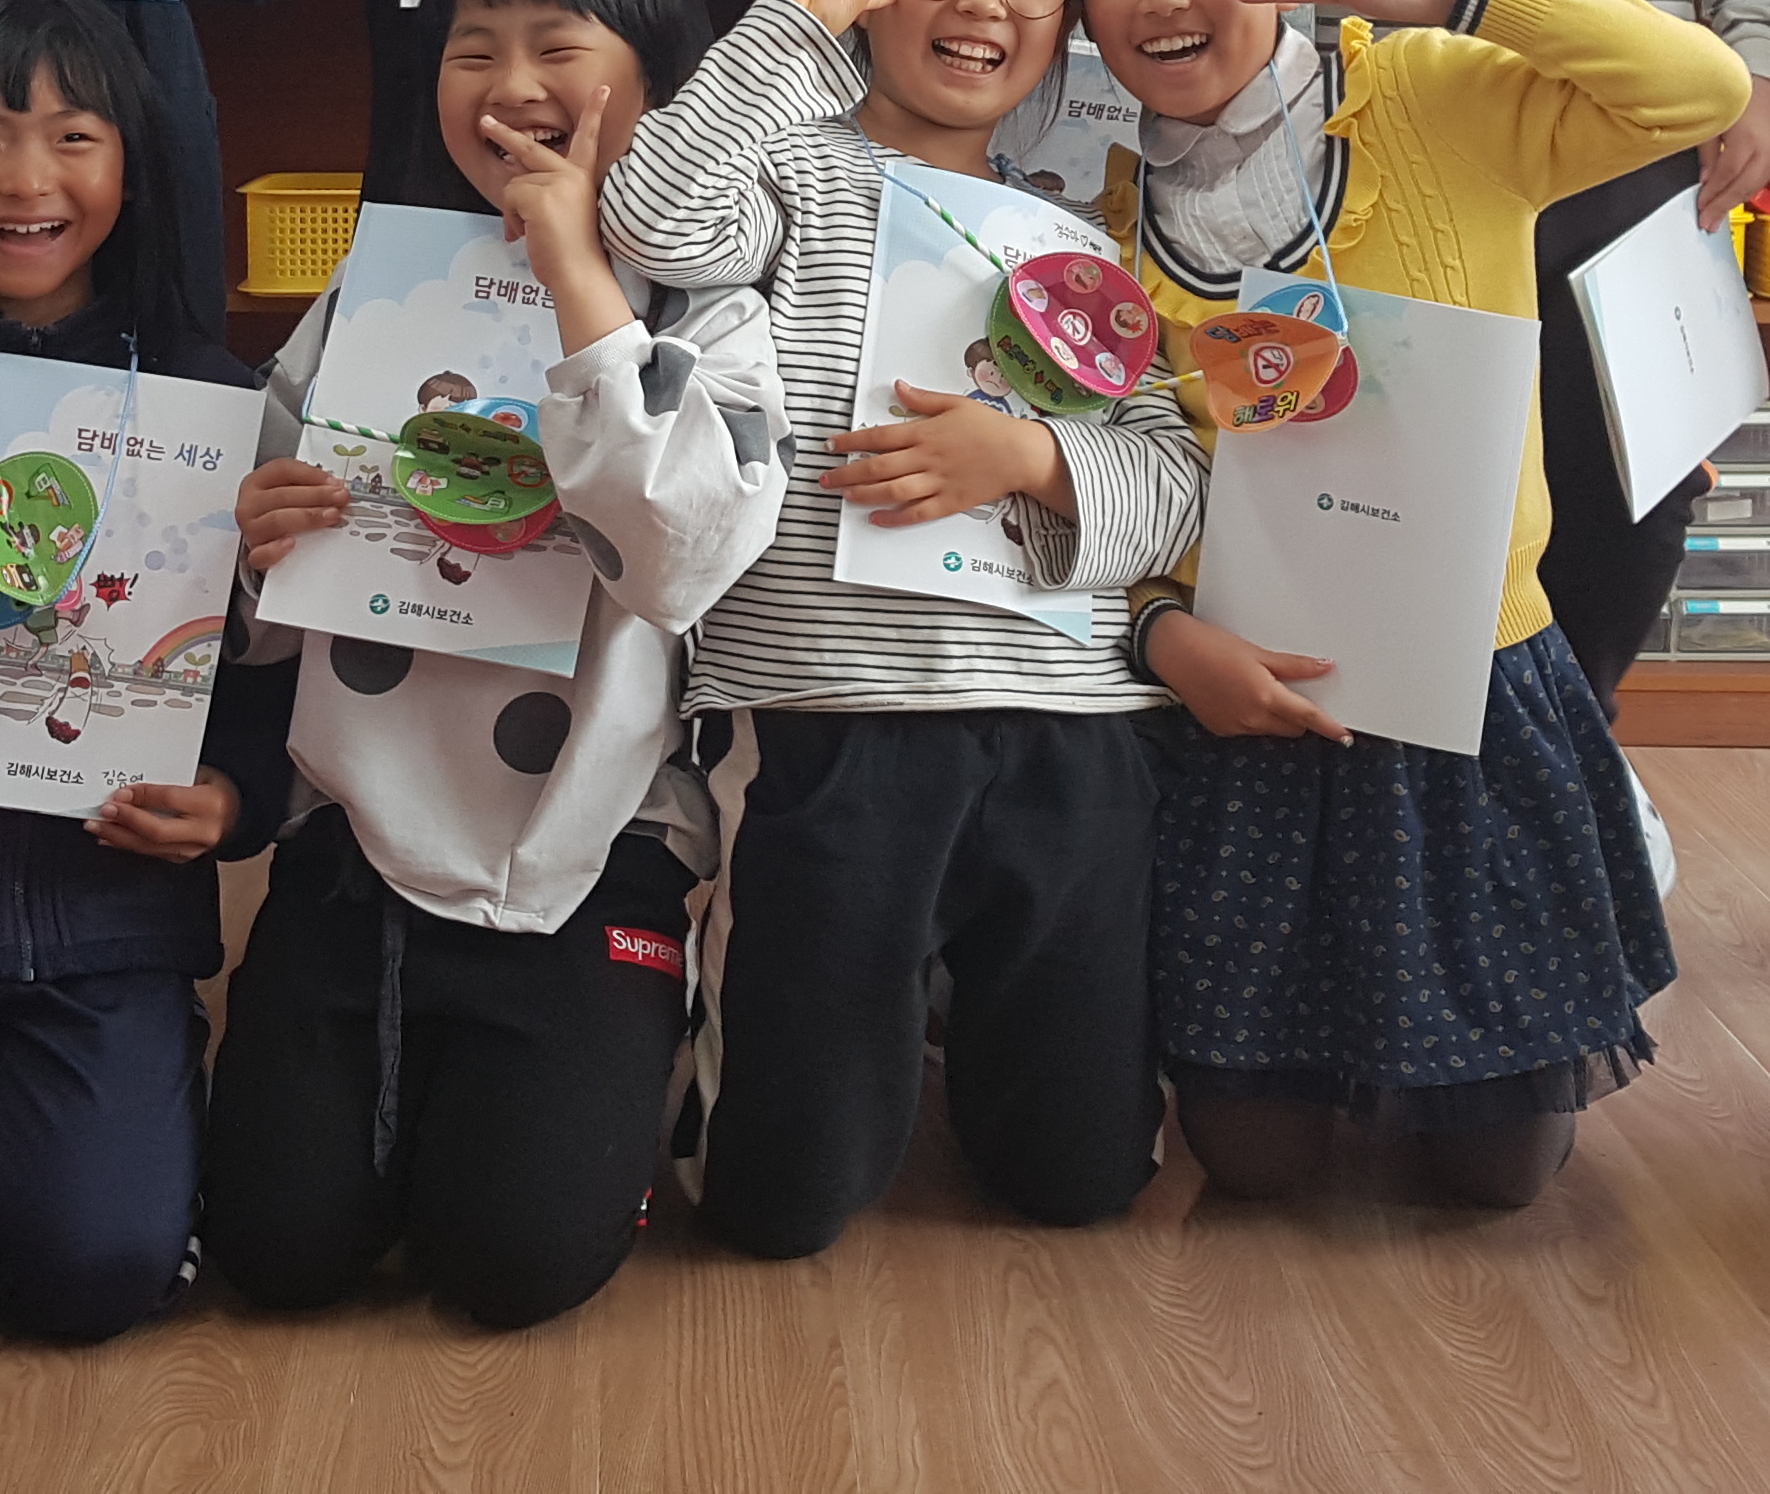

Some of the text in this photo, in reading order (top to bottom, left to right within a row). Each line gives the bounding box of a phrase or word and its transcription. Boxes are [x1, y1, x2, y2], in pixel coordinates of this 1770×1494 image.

[1232, 390, 1300, 427] 해로워
[175, 443, 224, 473] 세상
[1339, 499, 1401, 523] 김해시보건소
[397, 599, 474, 626] 김해시보건소
[5, 761, 85, 786] 김해시보건소
[612, 930, 684, 968] Supreme
